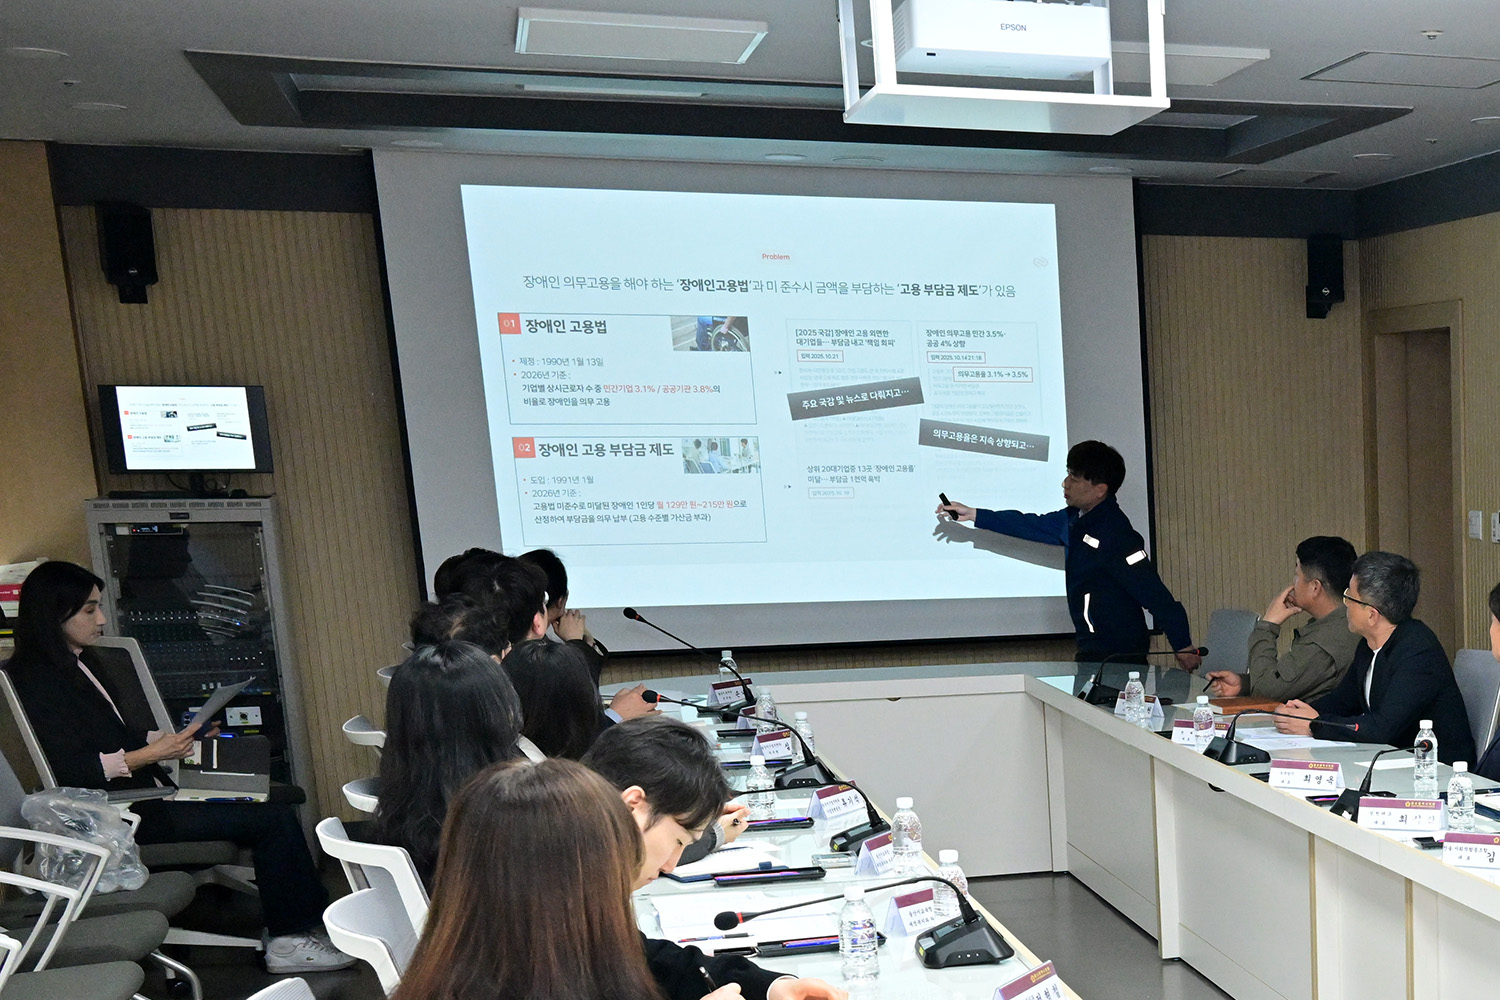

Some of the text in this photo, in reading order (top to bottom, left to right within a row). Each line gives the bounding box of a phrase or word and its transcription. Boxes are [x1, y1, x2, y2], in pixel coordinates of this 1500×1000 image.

[1000, 22, 1027, 33] EPSON
[523, 275, 560, 289] 장애인
[563, 276, 621, 291] 의무고용을
[623, 277, 648, 290] 해야
[651, 278, 674, 291] 하는
[766, 281, 777, 293] 미
[780, 281, 813, 294] 준수시
[816, 281, 849, 294] 금액을
[851, 282, 895, 295] 부담하는
[923, 284, 955, 296] 부담금
[994, 285, 1016, 298] 있음
[503, 319, 516, 328] 01
[526, 319, 607, 334] 장애인 고용법
[834, 329, 855, 337] 장애인
[927, 340, 939, 348] 공공
[519, 357, 534, 367] 제정
[541, 357, 570, 367] 1990년
[572, 358, 584, 367] 1월
[586, 358, 604, 367] 13일
[521, 370, 550, 380] 2026년
[551, 370, 567, 380] 기준
[522, 384, 545, 394] 기업별
[546, 384, 584, 393] 상시근로자
[603, 384, 633, 393] 민간기업
[635, 385, 655, 393] 3.1%
[662, 384, 691, 394] 공공기관
[579, 397, 594, 406] 의무
[596, 397, 610, 406] 고용
[802, 399, 818, 409] 주요
[819, 398, 834, 407] 국감
[846, 392, 869, 404] 뉴스로
[980, 435, 994, 446] 지속
[519, 443, 530, 452] 02
[539, 443, 675, 457] 장애인 고용 부담금 제도
[530, 475, 545, 485] 도입
[552, 475, 580, 485] 1991년
[582, 475, 594, 485] 1월
[532, 489, 560, 497] 2026년
[562, 488, 577, 498] 기준
[533, 501, 555, 510] 고용법
[611, 500, 634, 510] 장애인
[566, 514, 595, 524] 부담금을
[596, 514, 611, 523] 의무
[613, 514, 628, 523] 납부
